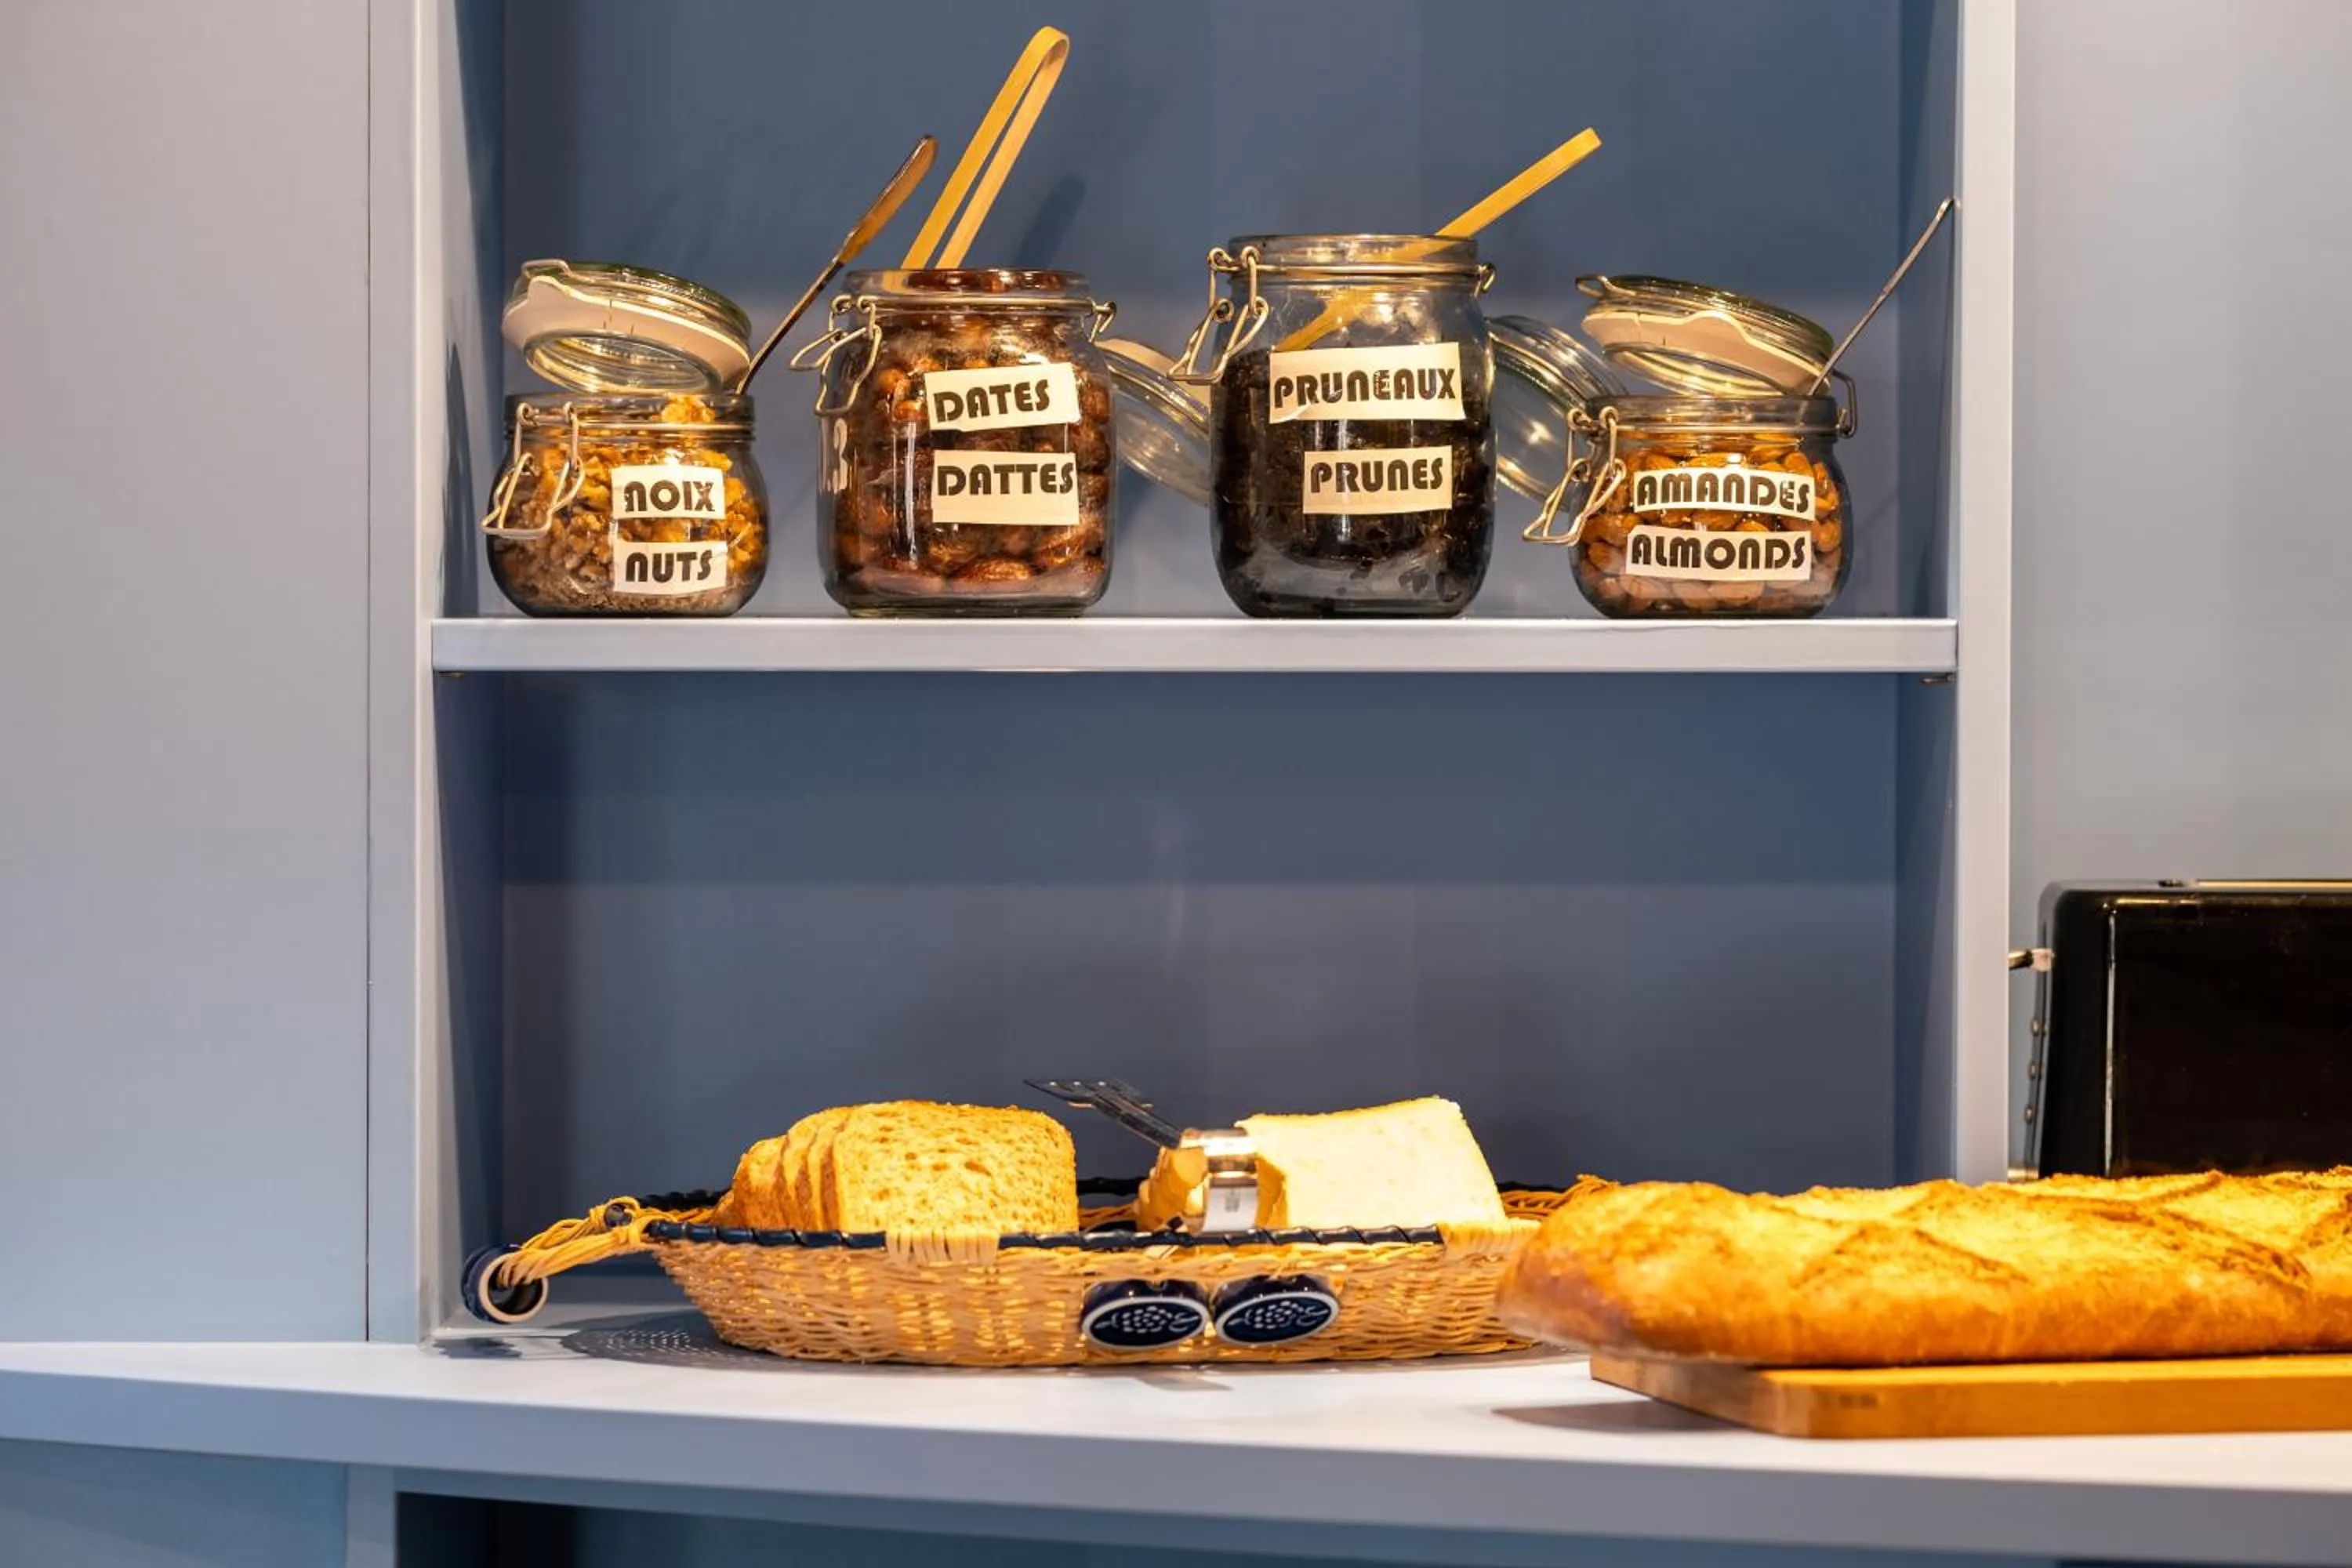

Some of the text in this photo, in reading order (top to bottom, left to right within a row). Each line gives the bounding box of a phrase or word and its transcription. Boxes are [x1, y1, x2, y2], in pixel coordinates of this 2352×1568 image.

[933, 379, 1051, 422] DATES
[1273, 367, 1457, 406] PRUNEAUX
[936, 463, 1076, 497] DATTES
[1310, 458, 1443, 493] PRUNES
[1636, 470, 1810, 512] AMANDES
[624, 480, 714, 512] NOIX
[626, 550, 712, 583] NUTS
[1632, 534, 1806, 569] ALMONDS
